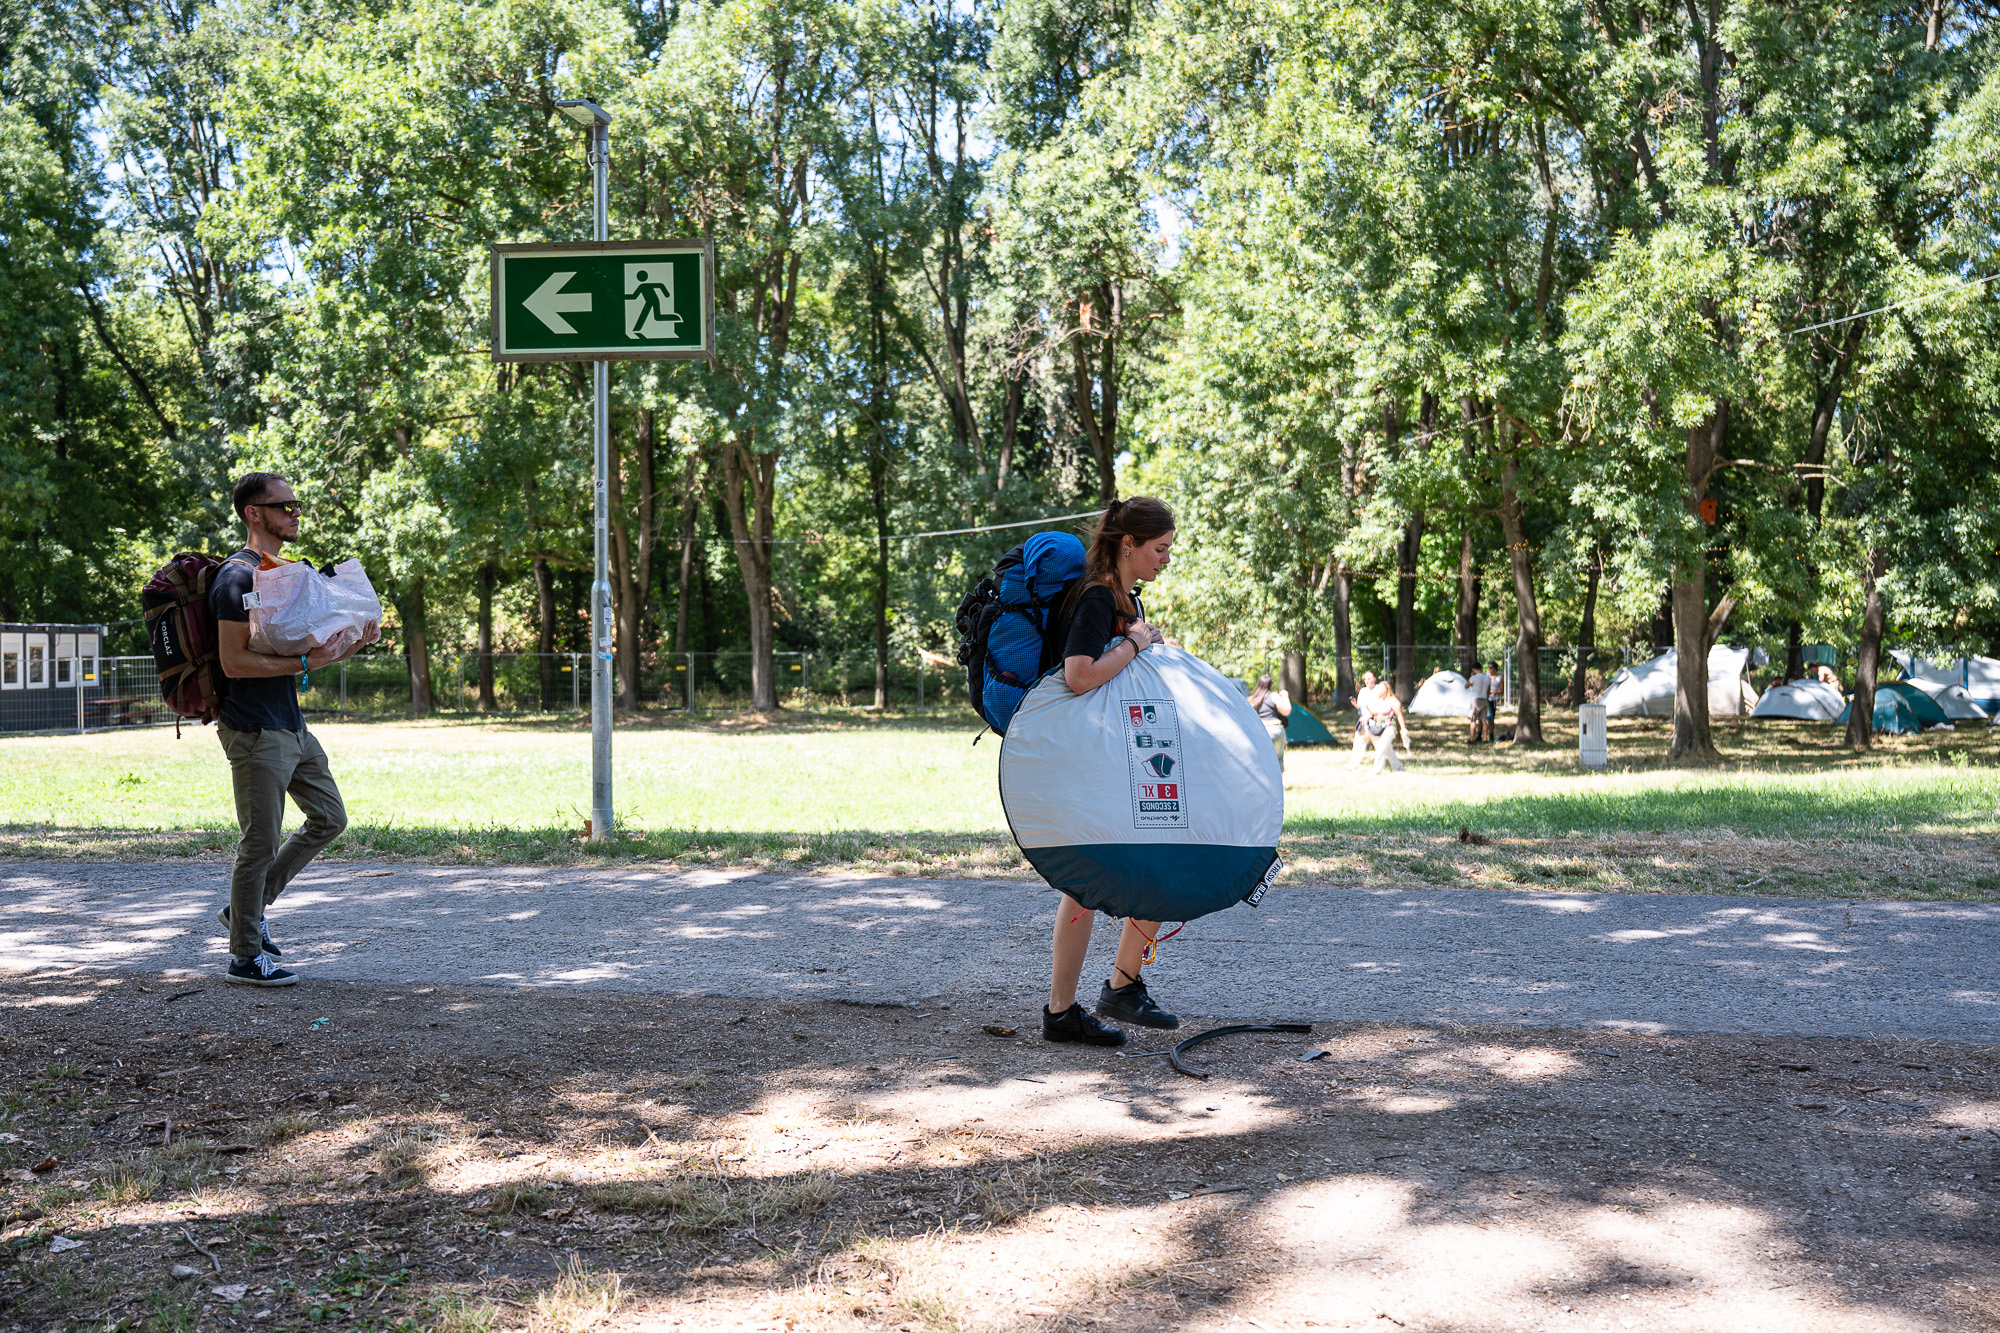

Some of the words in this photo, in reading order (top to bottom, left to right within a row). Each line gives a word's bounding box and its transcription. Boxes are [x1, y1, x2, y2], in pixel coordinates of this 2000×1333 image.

[161, 621, 173, 656] FORCLAZ
[1141, 785, 1155, 797] XL
[1164, 785, 1171, 797] 3
[1141, 802, 1171, 811] SECONDS
[1172, 802, 1177, 810] 2
[1265, 863, 1281, 882] FRESH
[1251, 884, 1267, 902] BLACK
